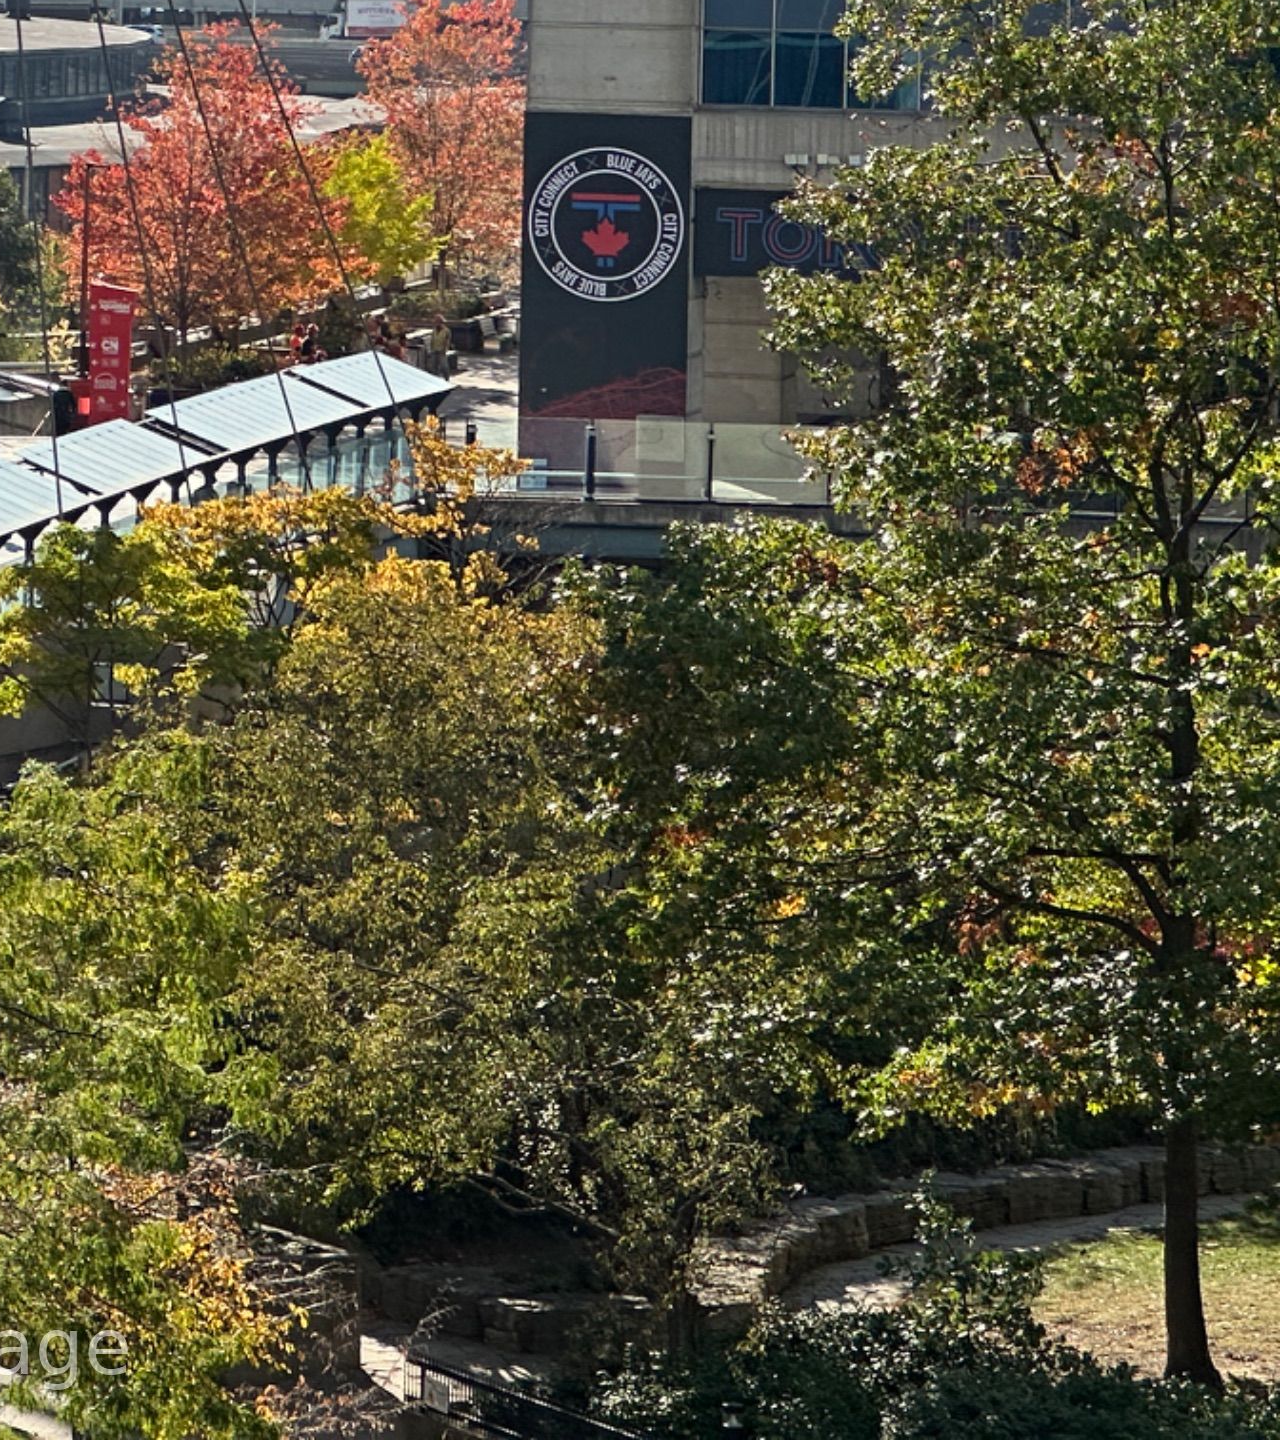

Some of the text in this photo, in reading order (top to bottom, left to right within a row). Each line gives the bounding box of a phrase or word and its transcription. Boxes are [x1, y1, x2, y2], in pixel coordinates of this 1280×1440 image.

[534, 161, 581, 237] CITY CONNECT
[607, 153, 662, 190] BLUE JAYS
[552, 260, 607, 296] BLUE JAYS
[632, 212, 679, 290] CITY CONNECT
